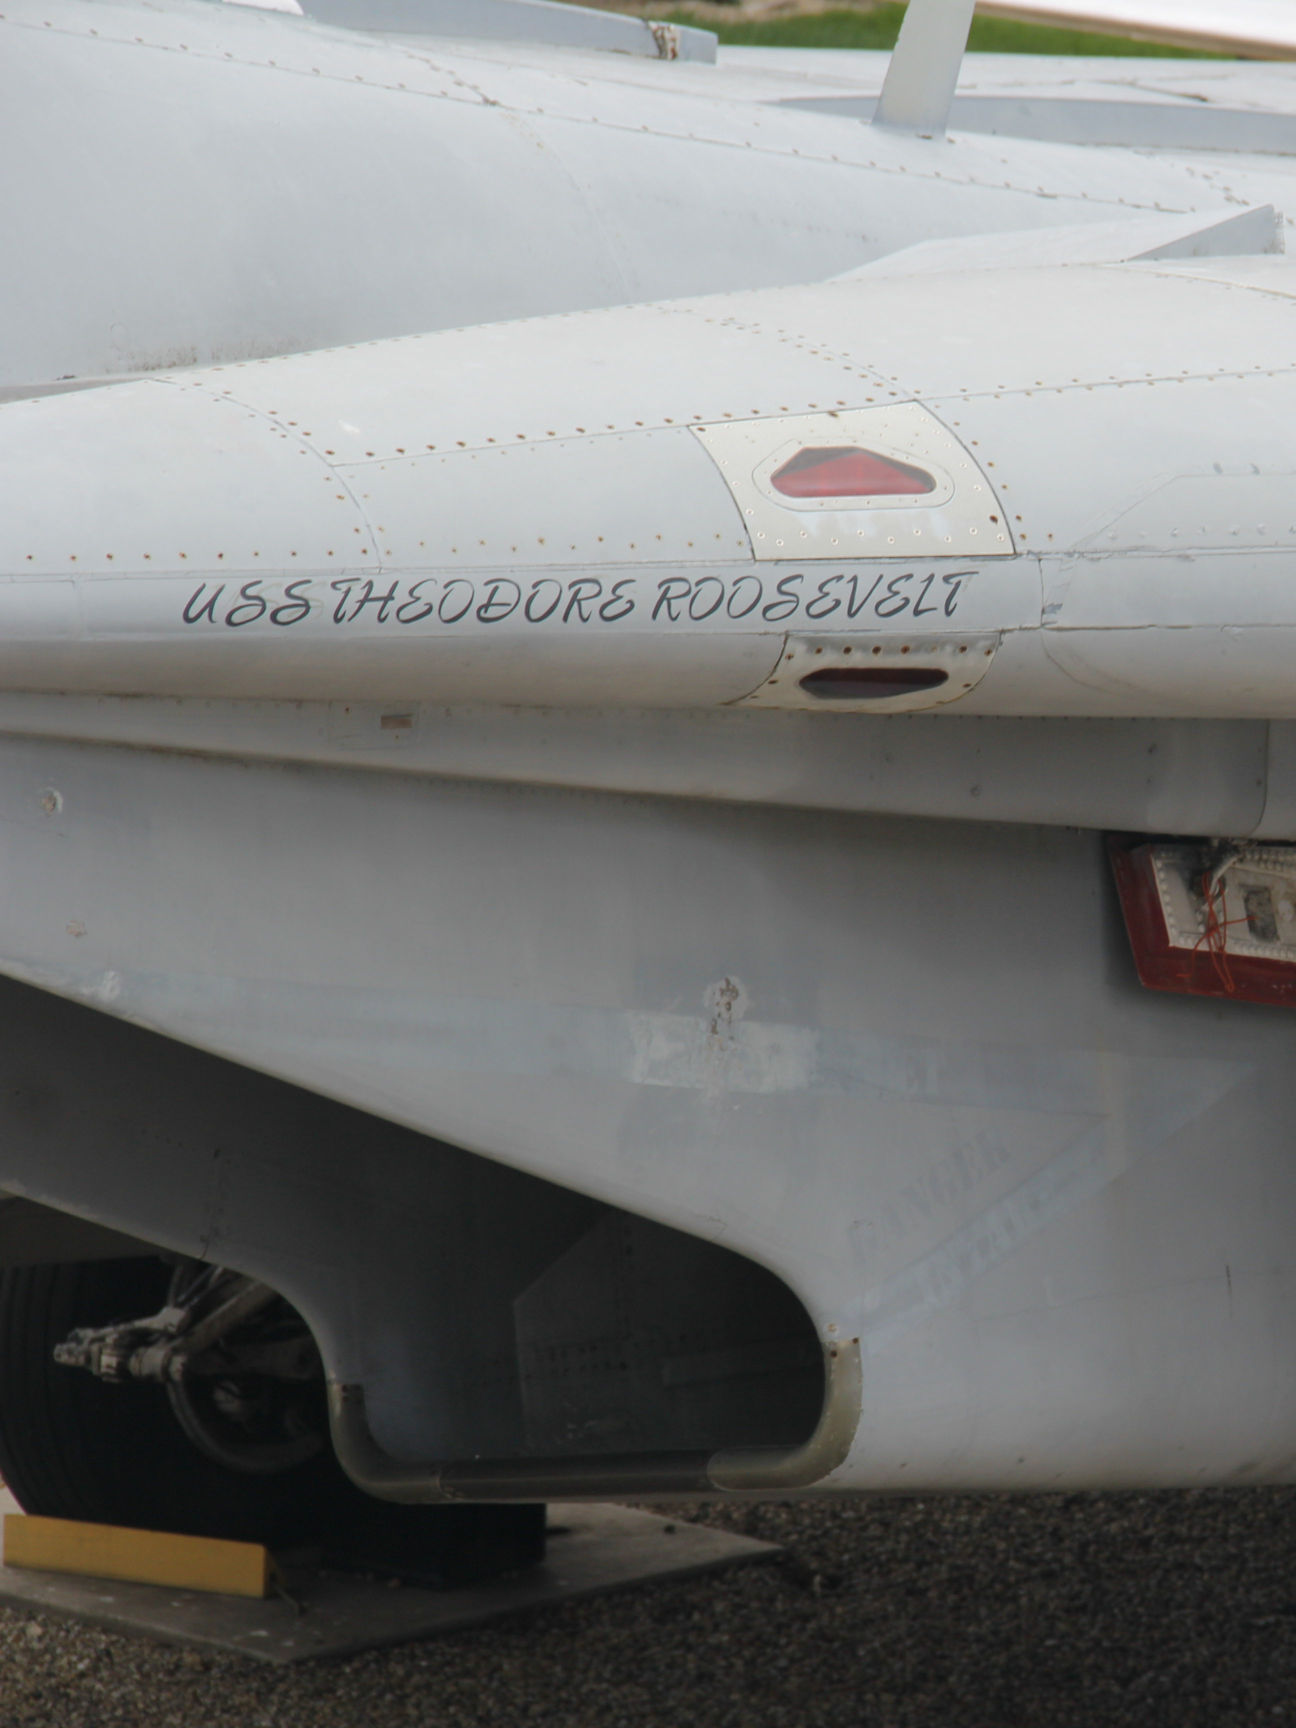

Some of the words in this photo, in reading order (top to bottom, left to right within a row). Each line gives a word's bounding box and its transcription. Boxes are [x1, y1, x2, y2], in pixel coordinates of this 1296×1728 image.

[182, 578, 313, 628] USS
[329, 577, 638, 624] THEODORE
[650, 570, 981, 623] ROOSEVELT
